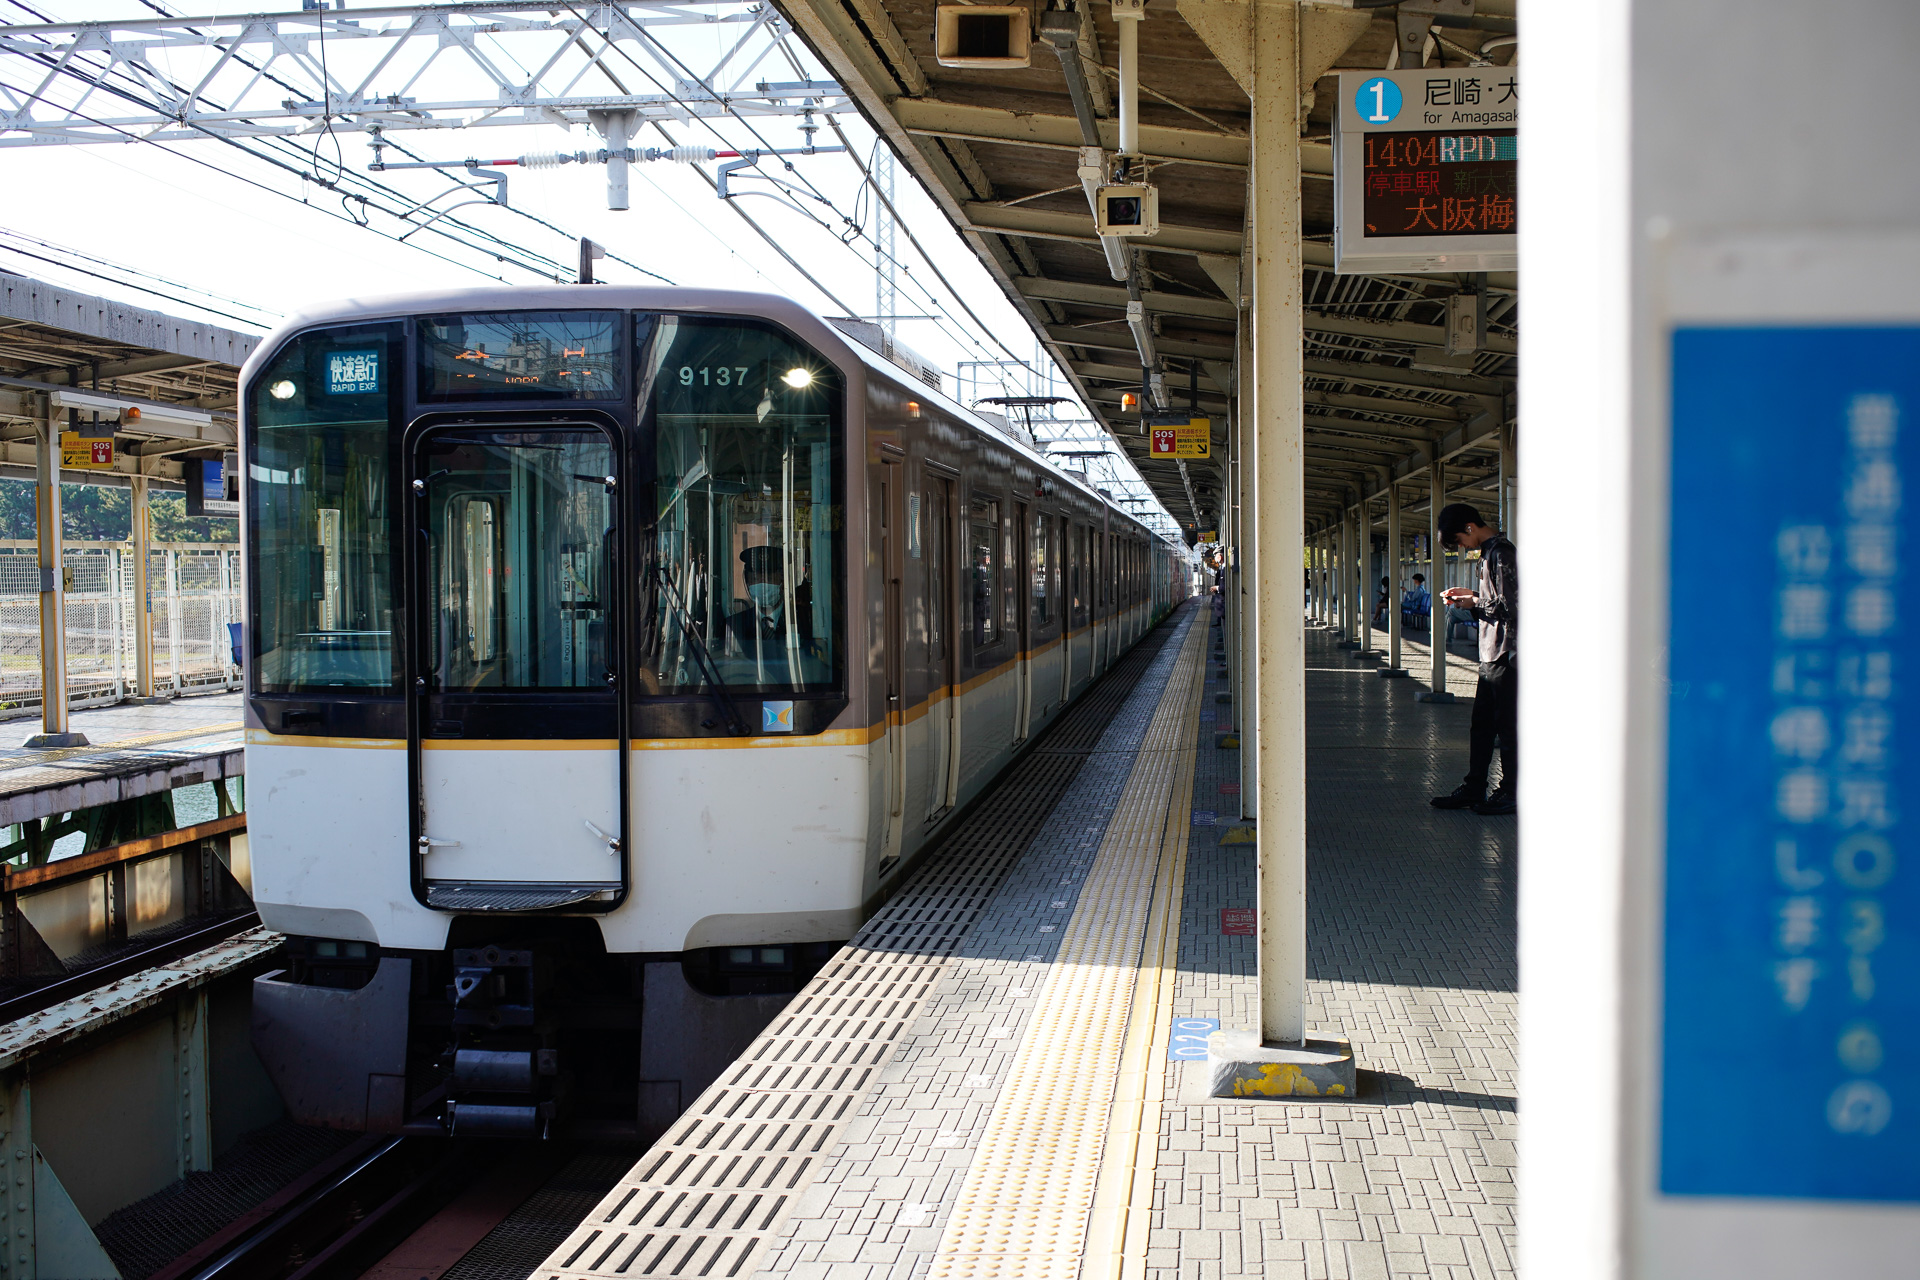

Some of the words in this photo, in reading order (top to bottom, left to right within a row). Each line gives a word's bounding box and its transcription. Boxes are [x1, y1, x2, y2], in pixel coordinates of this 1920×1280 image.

[1369, 81, 1389, 121] 1
[1424, 111, 1442, 124] for
[1365, 137, 1439, 167] 14:04
[1441, 136, 1496, 161] RPD
[1365, 171, 1440, 197] 停車駅
[330, 354, 378, 383] 快速急行
[679, 366, 748, 386] 9137
[331, 383, 356, 392] RAPID
[359, 382, 377, 391] EXP.
